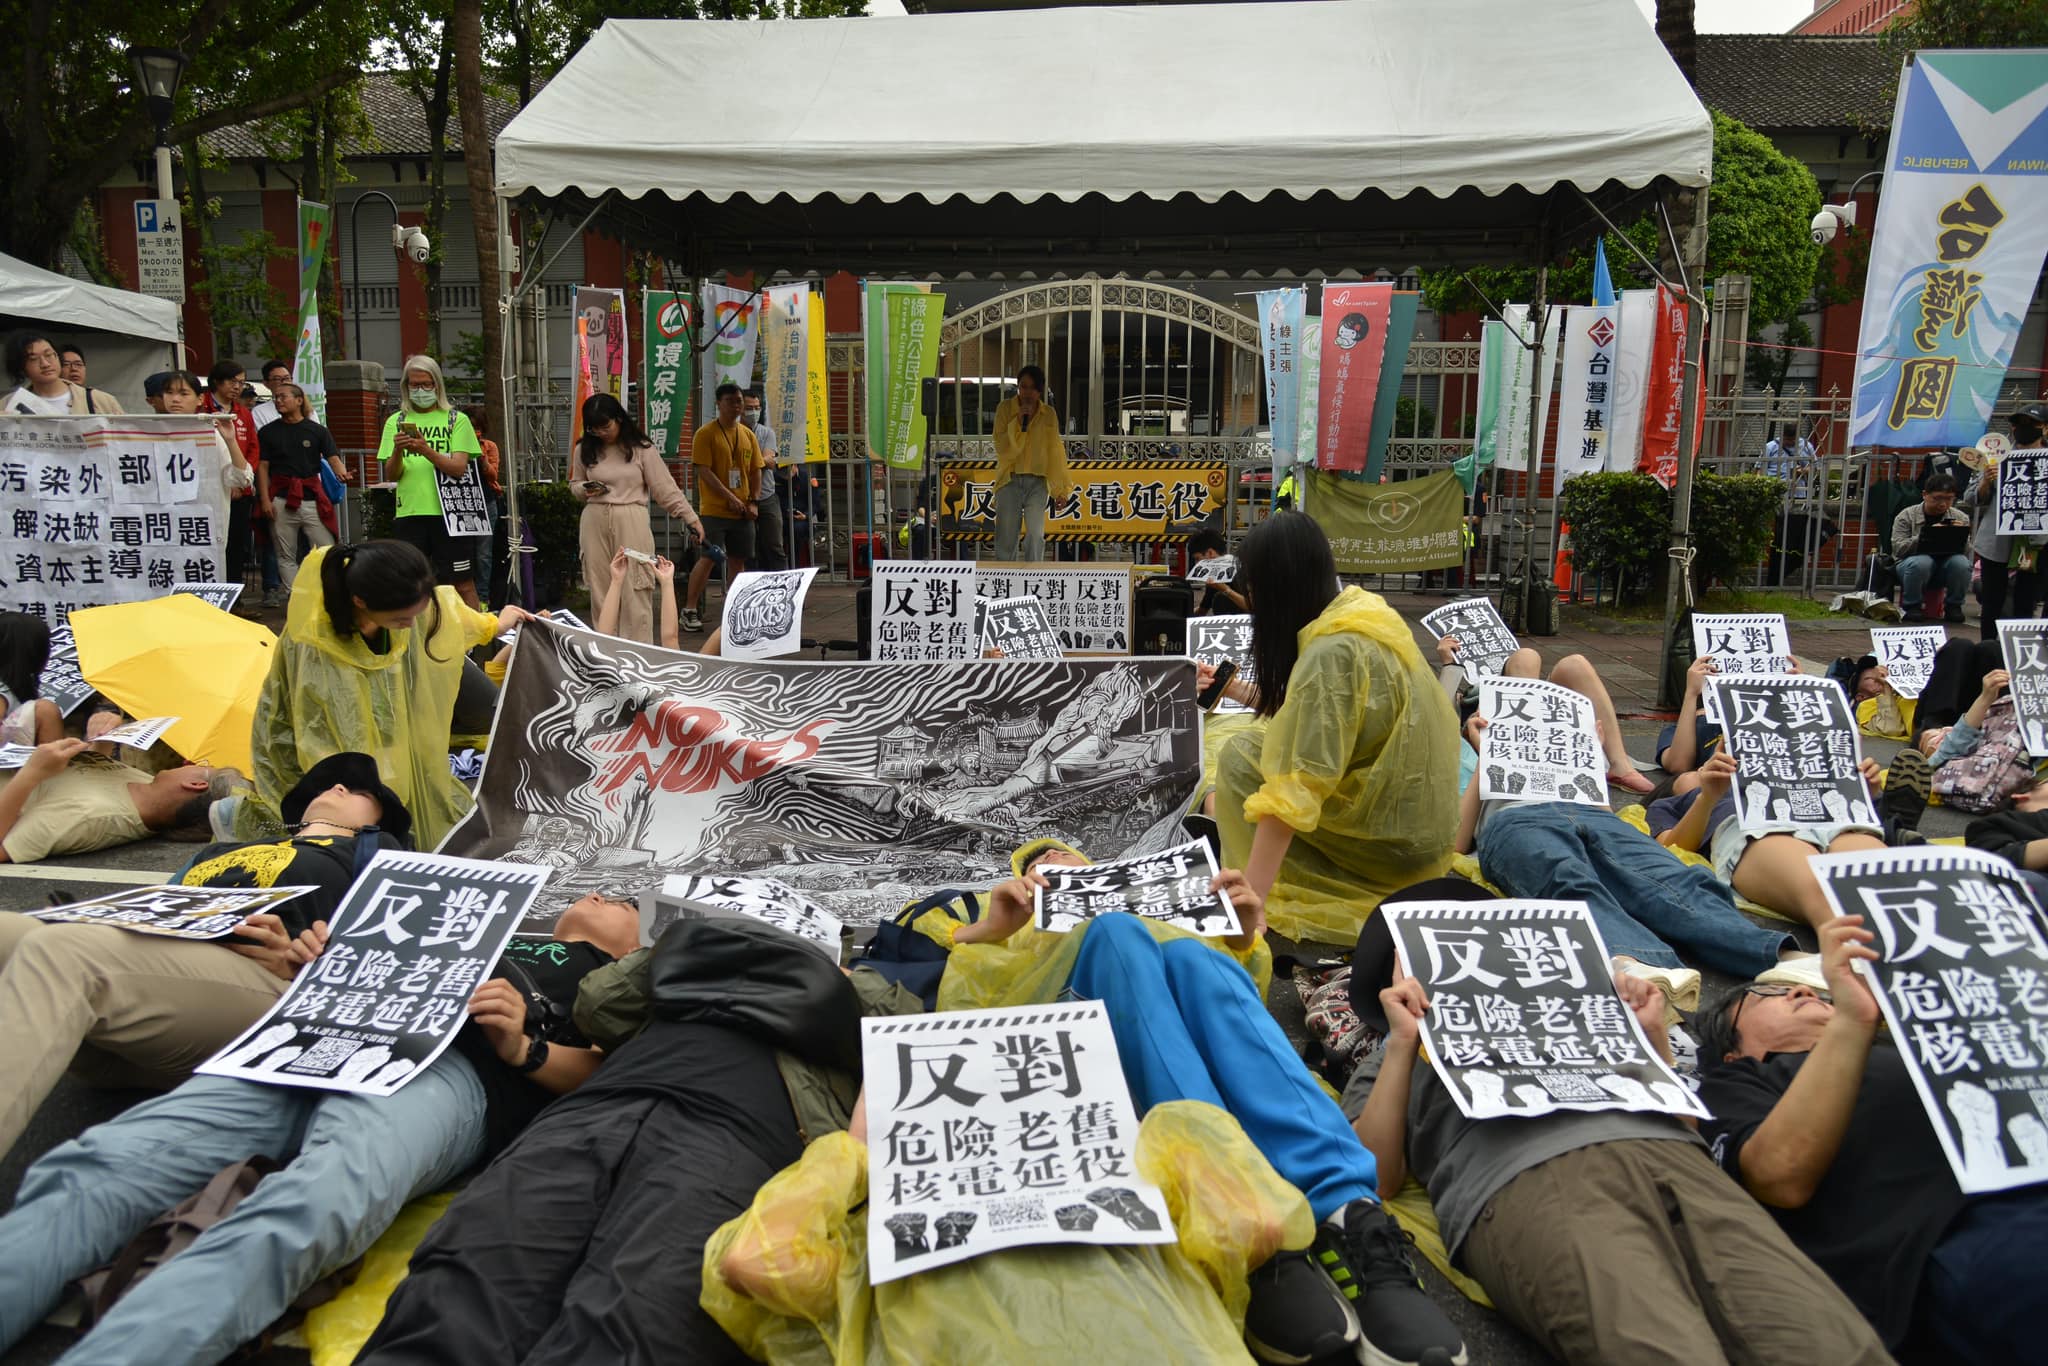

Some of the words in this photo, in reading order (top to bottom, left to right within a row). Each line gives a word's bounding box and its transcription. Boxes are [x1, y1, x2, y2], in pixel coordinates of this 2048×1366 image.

[1280, 325, 1292, 373] 綠主張
[892, 297, 927, 463] 綠色公民行動聯盟
[1580, 352, 1611, 460] 台灣基進
[0, 453, 196, 496] 污染外部化
[12, 508, 212, 547] 解決缺電問題
[0, 549, 216, 588] 資本主導綠能
[881, 578, 963, 618] 反對
[1023, 579, 1068, 601] 反對
[1074, 602, 1126, 616] 危險老舊
[1078, 579, 1123, 601] 反對
[736, 602, 786, 635] NUKES
[876, 620, 968, 646] 危險老舊
[989, 607, 1042, 638] 反對
[1074, 614, 1126, 629] 核電延役
[1434, 606, 1496, 635] 反對
[1144, 640, 1183, 652] MIRO
[1457, 639, 1516, 660] 核電延役
[1705, 626, 1776, 655] 反對
[592, 701, 729, 753] NO
[1492, 690, 1583, 729] 反對
[1730, 689, 1833, 730] 反對
[1487, 722, 1594, 752] 危險老舊
[1487, 741, 1597, 770] 核電延役
[1732, 729, 1852, 757] 危險老舊
[594, 720, 839, 796] NUKES
[1737, 753, 1858, 782] 核電延役
[1052, 855, 1194, 893] 反對
[341, 878, 511, 953] 反對
[1856, 879, 2048, 965] 反對
[313, 942, 486, 999] 危險老舊
[1418, 926, 1588, 990] 反對
[283, 985, 460, 1038] 核電延役
[1428, 991, 1628, 1035] 危險老舊
[1887, 965, 2048, 1023] 危險老
[1437, 1033, 1650, 1068] 核電延役
[890, 1030, 1086, 1112] 反對
[880, 1101, 1119, 1169] 危險老舊
[886, 1145, 1131, 1207] 核電延役
